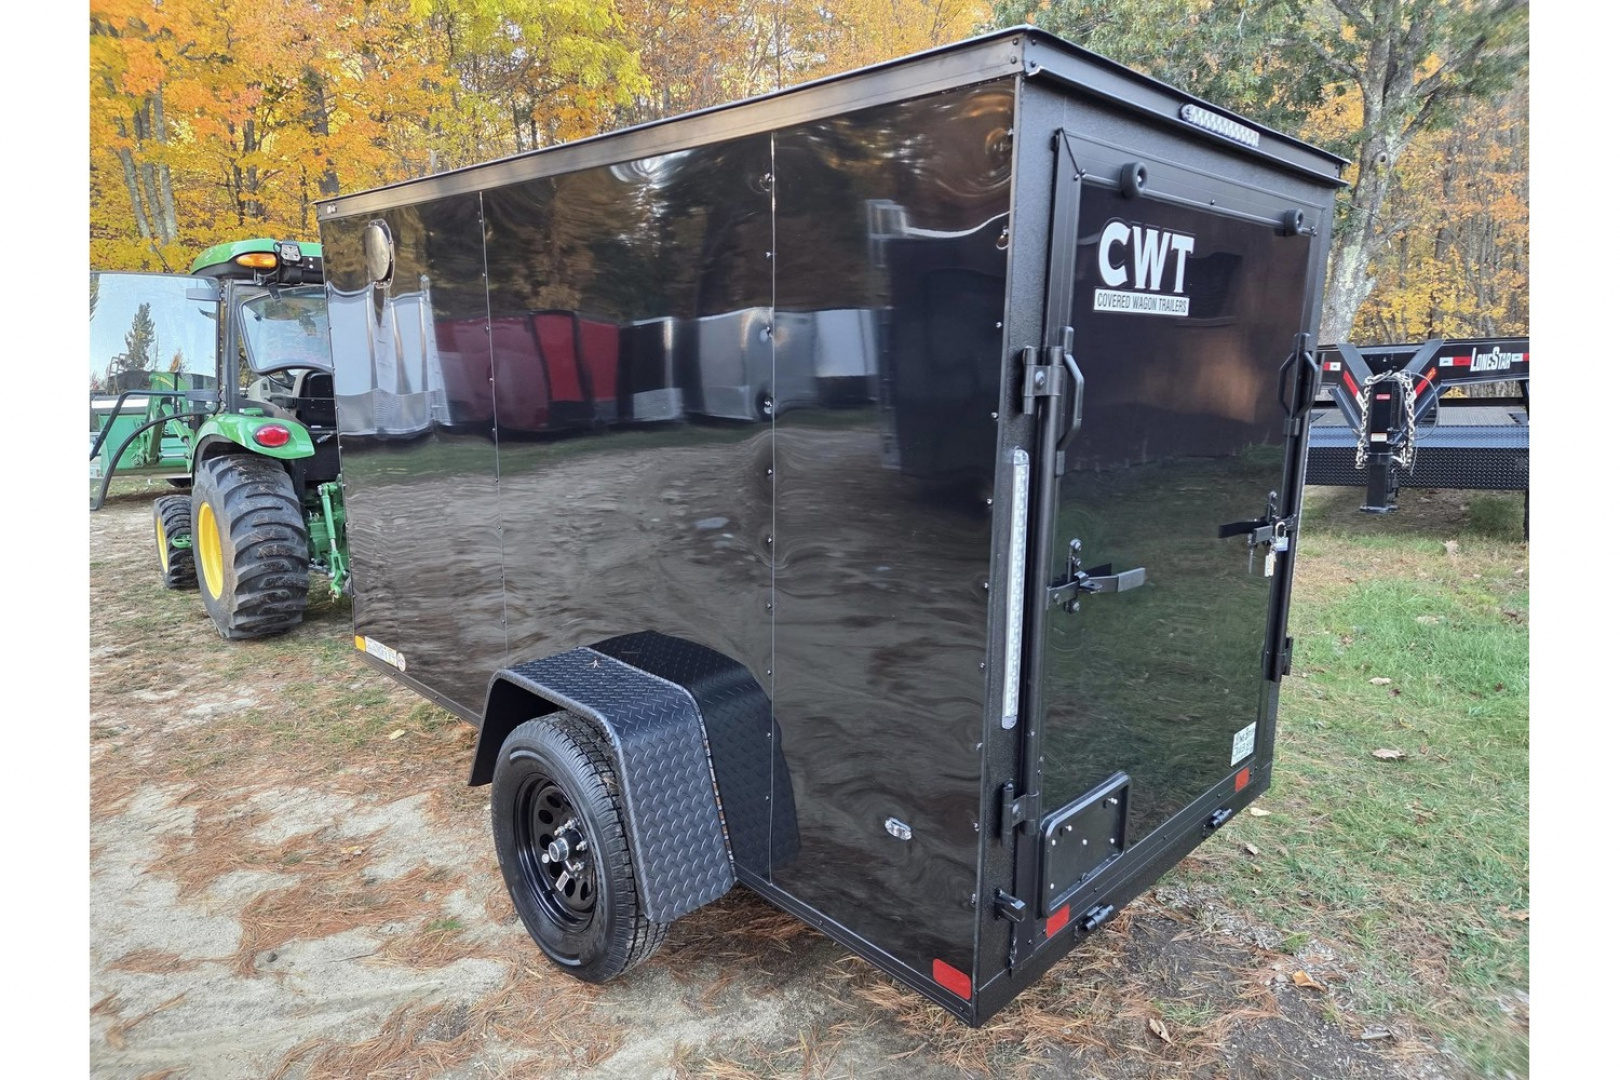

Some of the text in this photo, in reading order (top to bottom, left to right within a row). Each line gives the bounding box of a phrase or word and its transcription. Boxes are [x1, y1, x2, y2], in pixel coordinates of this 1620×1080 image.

[1099, 221, 1195, 293] CWT
[1097, 293, 1187, 313] COVERED WAGON TRAILERS
